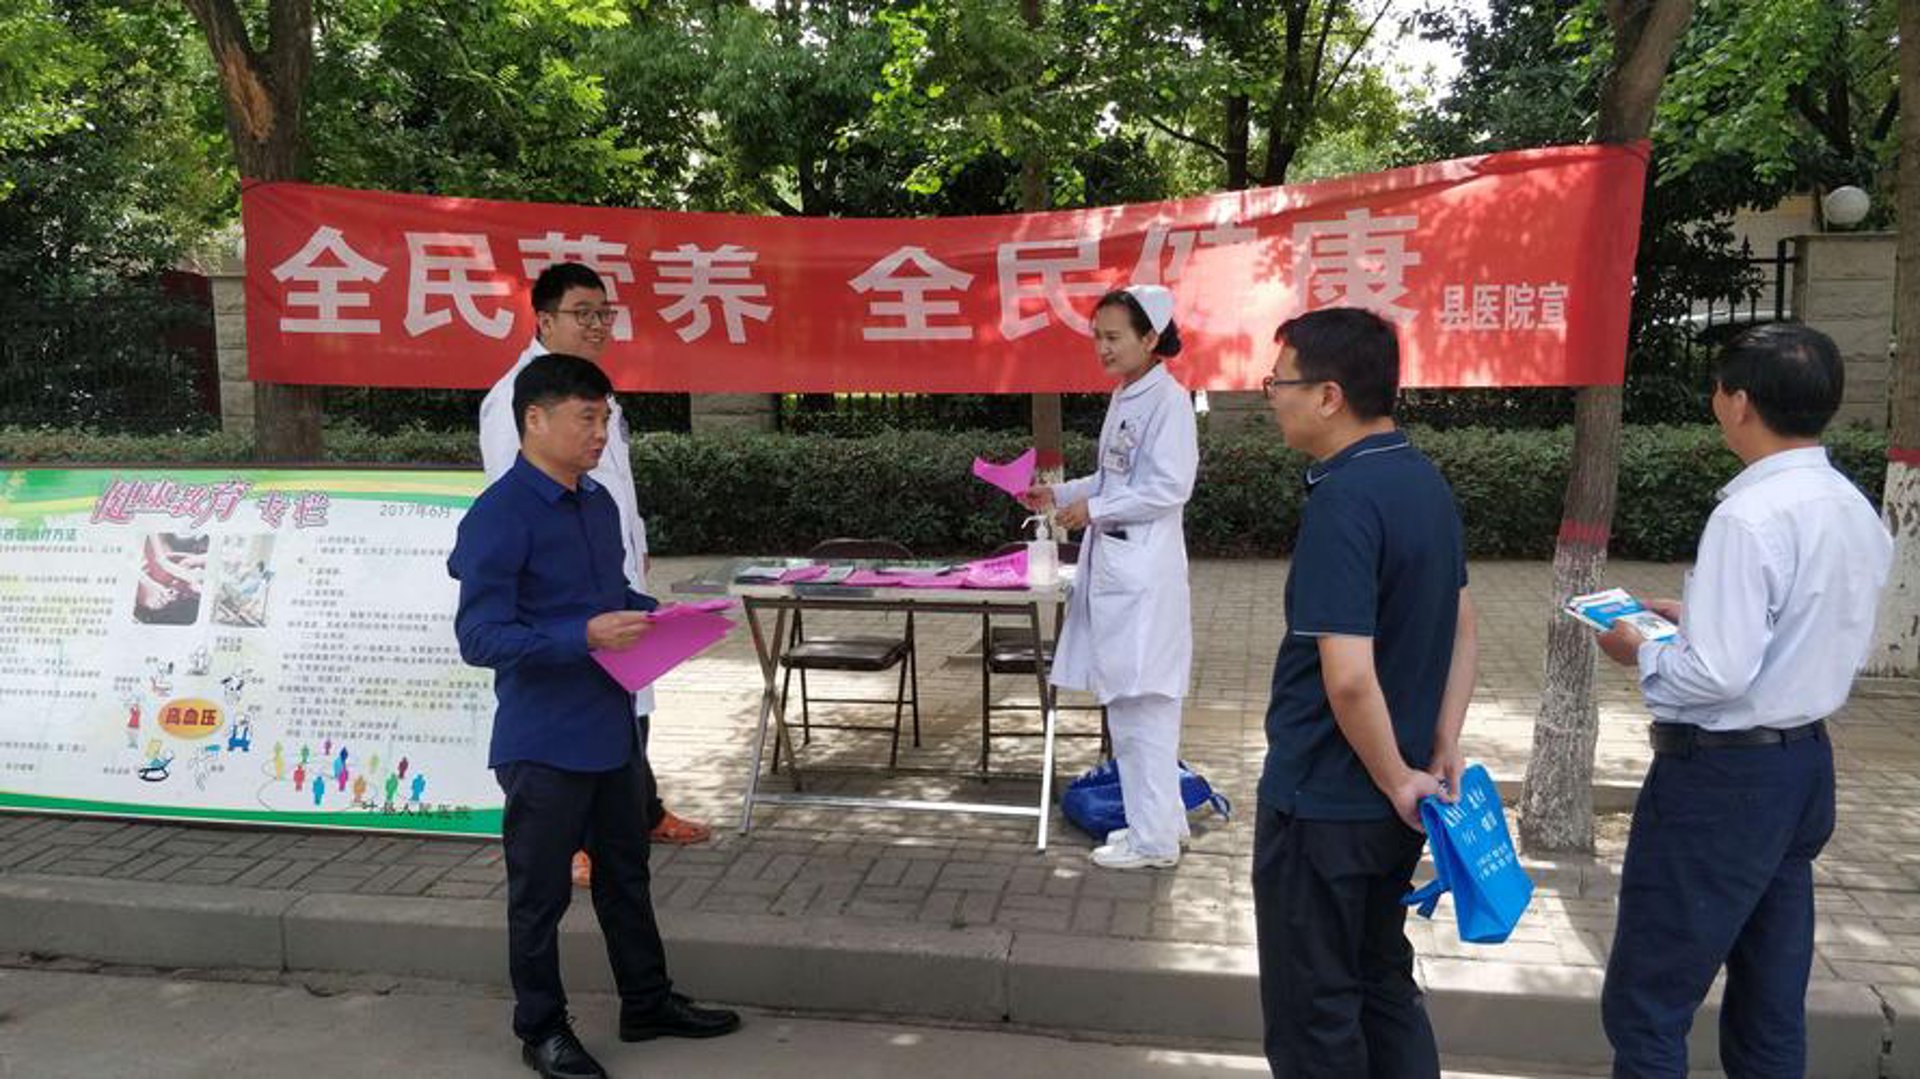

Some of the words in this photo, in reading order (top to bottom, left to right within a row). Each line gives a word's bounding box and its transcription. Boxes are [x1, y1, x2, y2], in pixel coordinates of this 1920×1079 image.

[271, 226, 773, 344] 全民营养
[1438, 282, 1568, 330] 县医院宣
[258, 490, 330, 529] 专栏
[379, 503, 451, 519] 2017年6月
[165, 706, 218, 727] 高血压
